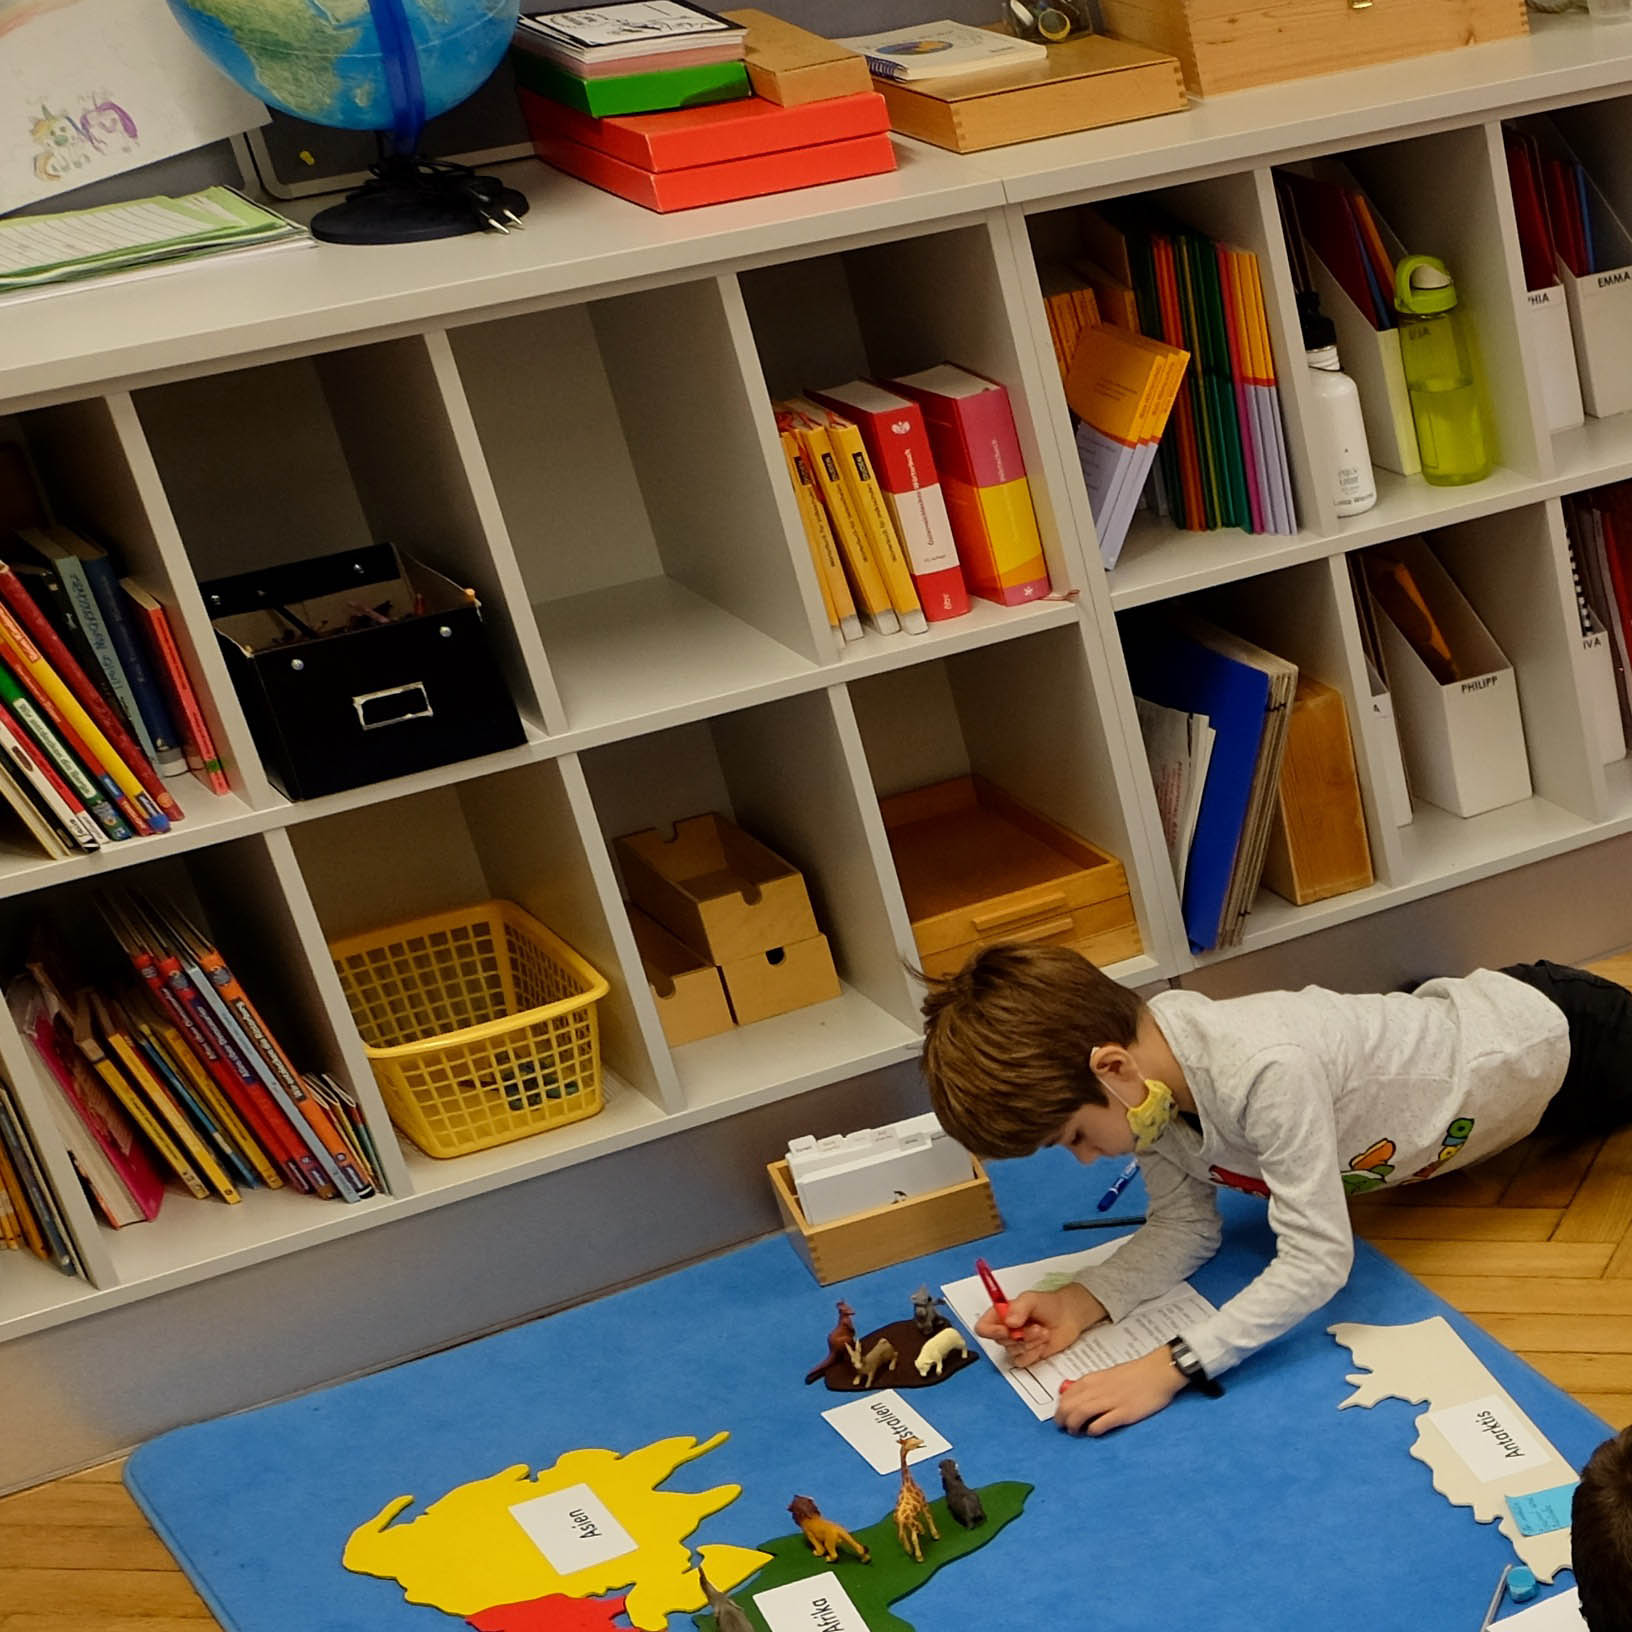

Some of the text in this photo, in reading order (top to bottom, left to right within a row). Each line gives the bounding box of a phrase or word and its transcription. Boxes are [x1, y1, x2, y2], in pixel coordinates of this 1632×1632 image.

[1597, 270, 1631, 288] EMMA
[1460, 675, 1498, 693] PHILIPP
[869, 1400, 927, 1450] stralien
[1476, 1407, 1526, 1460] Antarktis
[568, 1506, 605, 1541] Asien
